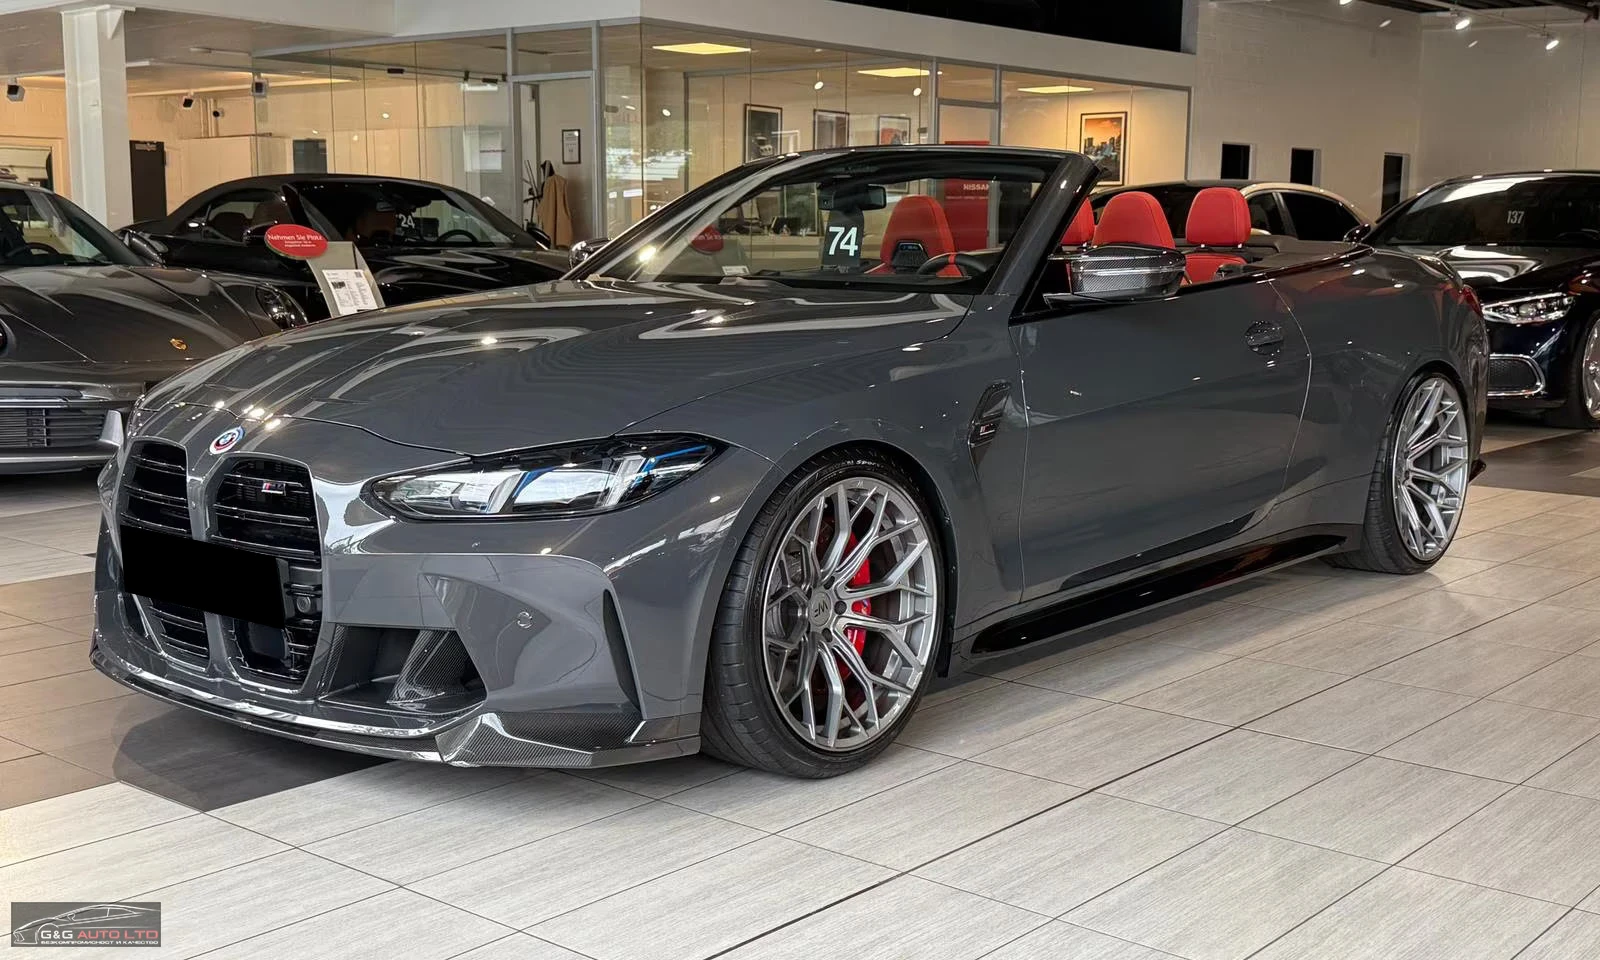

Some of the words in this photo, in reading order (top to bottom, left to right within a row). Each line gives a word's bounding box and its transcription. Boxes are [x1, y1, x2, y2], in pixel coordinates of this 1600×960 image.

[398, 213, 415, 228] 24
[1507, 210, 1525, 224] 137
[828, 226, 858, 257] 74
